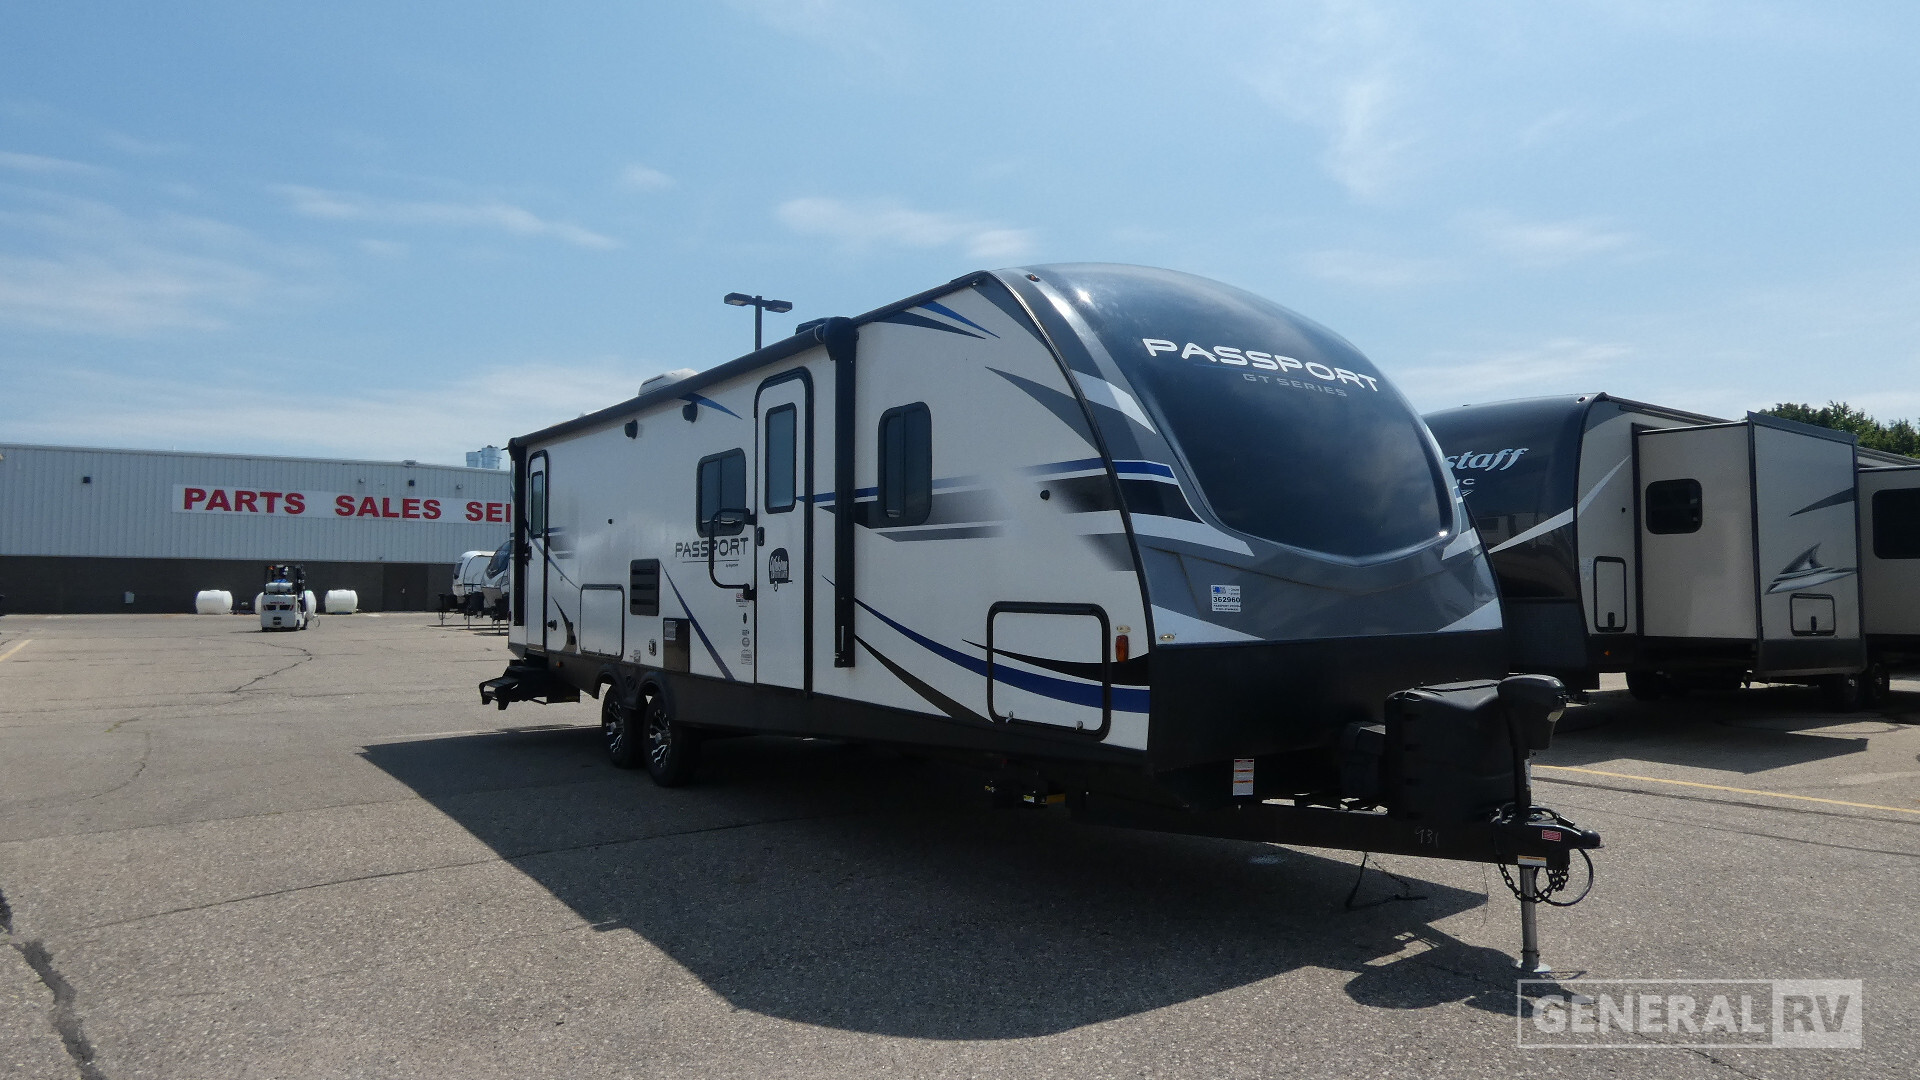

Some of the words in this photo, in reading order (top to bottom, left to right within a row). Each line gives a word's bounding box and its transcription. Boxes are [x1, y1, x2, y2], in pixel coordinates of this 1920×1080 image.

[1141, 338, 1379, 392] PASSPORT
[1242, 373, 1270, 385] GT
[1276, 377, 1348, 397] SERIES
[184, 487, 306, 515] PARTS
[334, 494, 442, 519] SALES
[675, 537, 749, 558] PASSPORT
